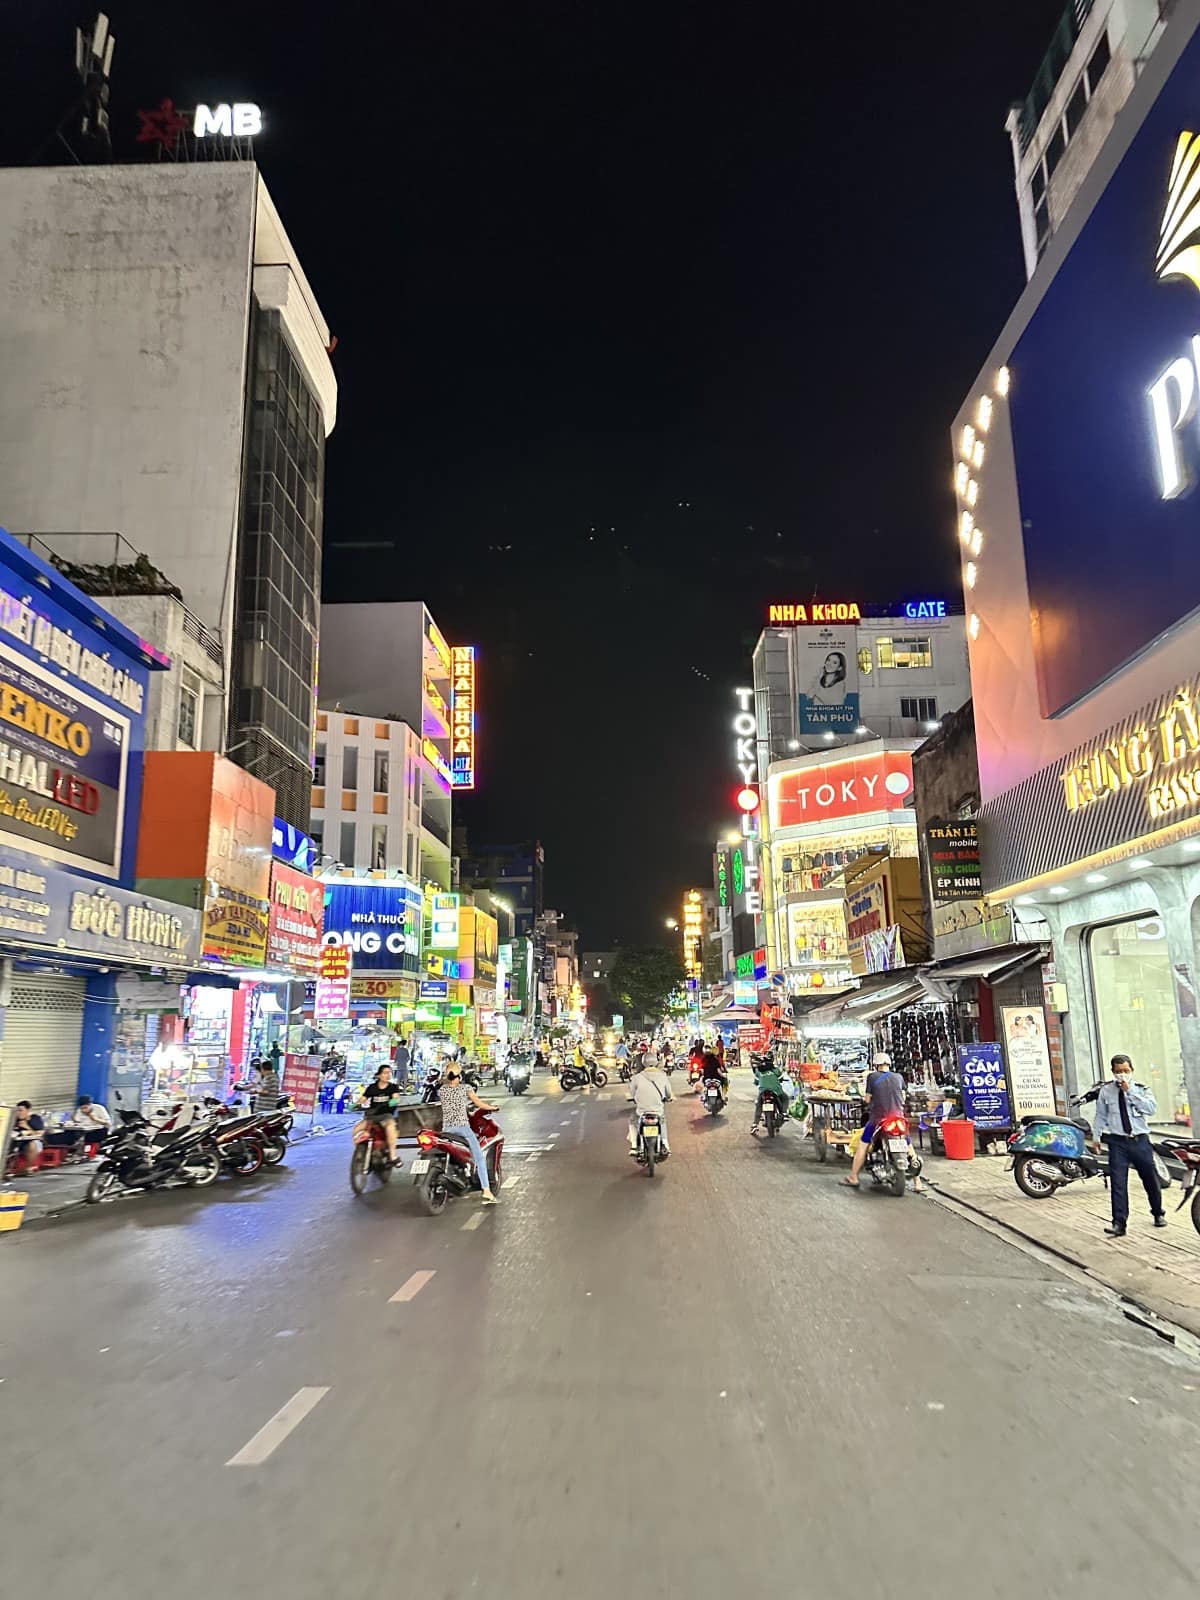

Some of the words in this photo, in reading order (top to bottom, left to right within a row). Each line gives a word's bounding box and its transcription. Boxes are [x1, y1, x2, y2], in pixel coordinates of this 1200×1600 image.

[193, 102, 262, 137] MB
[770, 605, 807, 621] NHA
[813, 603, 861, 620] KHOA
[906, 601, 946, 618] GATE
[806, 711, 828, 722] TÂN
[949, 839, 978, 847] mobile
[954, 876, 981, 887] KÍNH
[351, 911, 376, 924] NHÀ
[1018, 1101, 1033, 1109] 100
